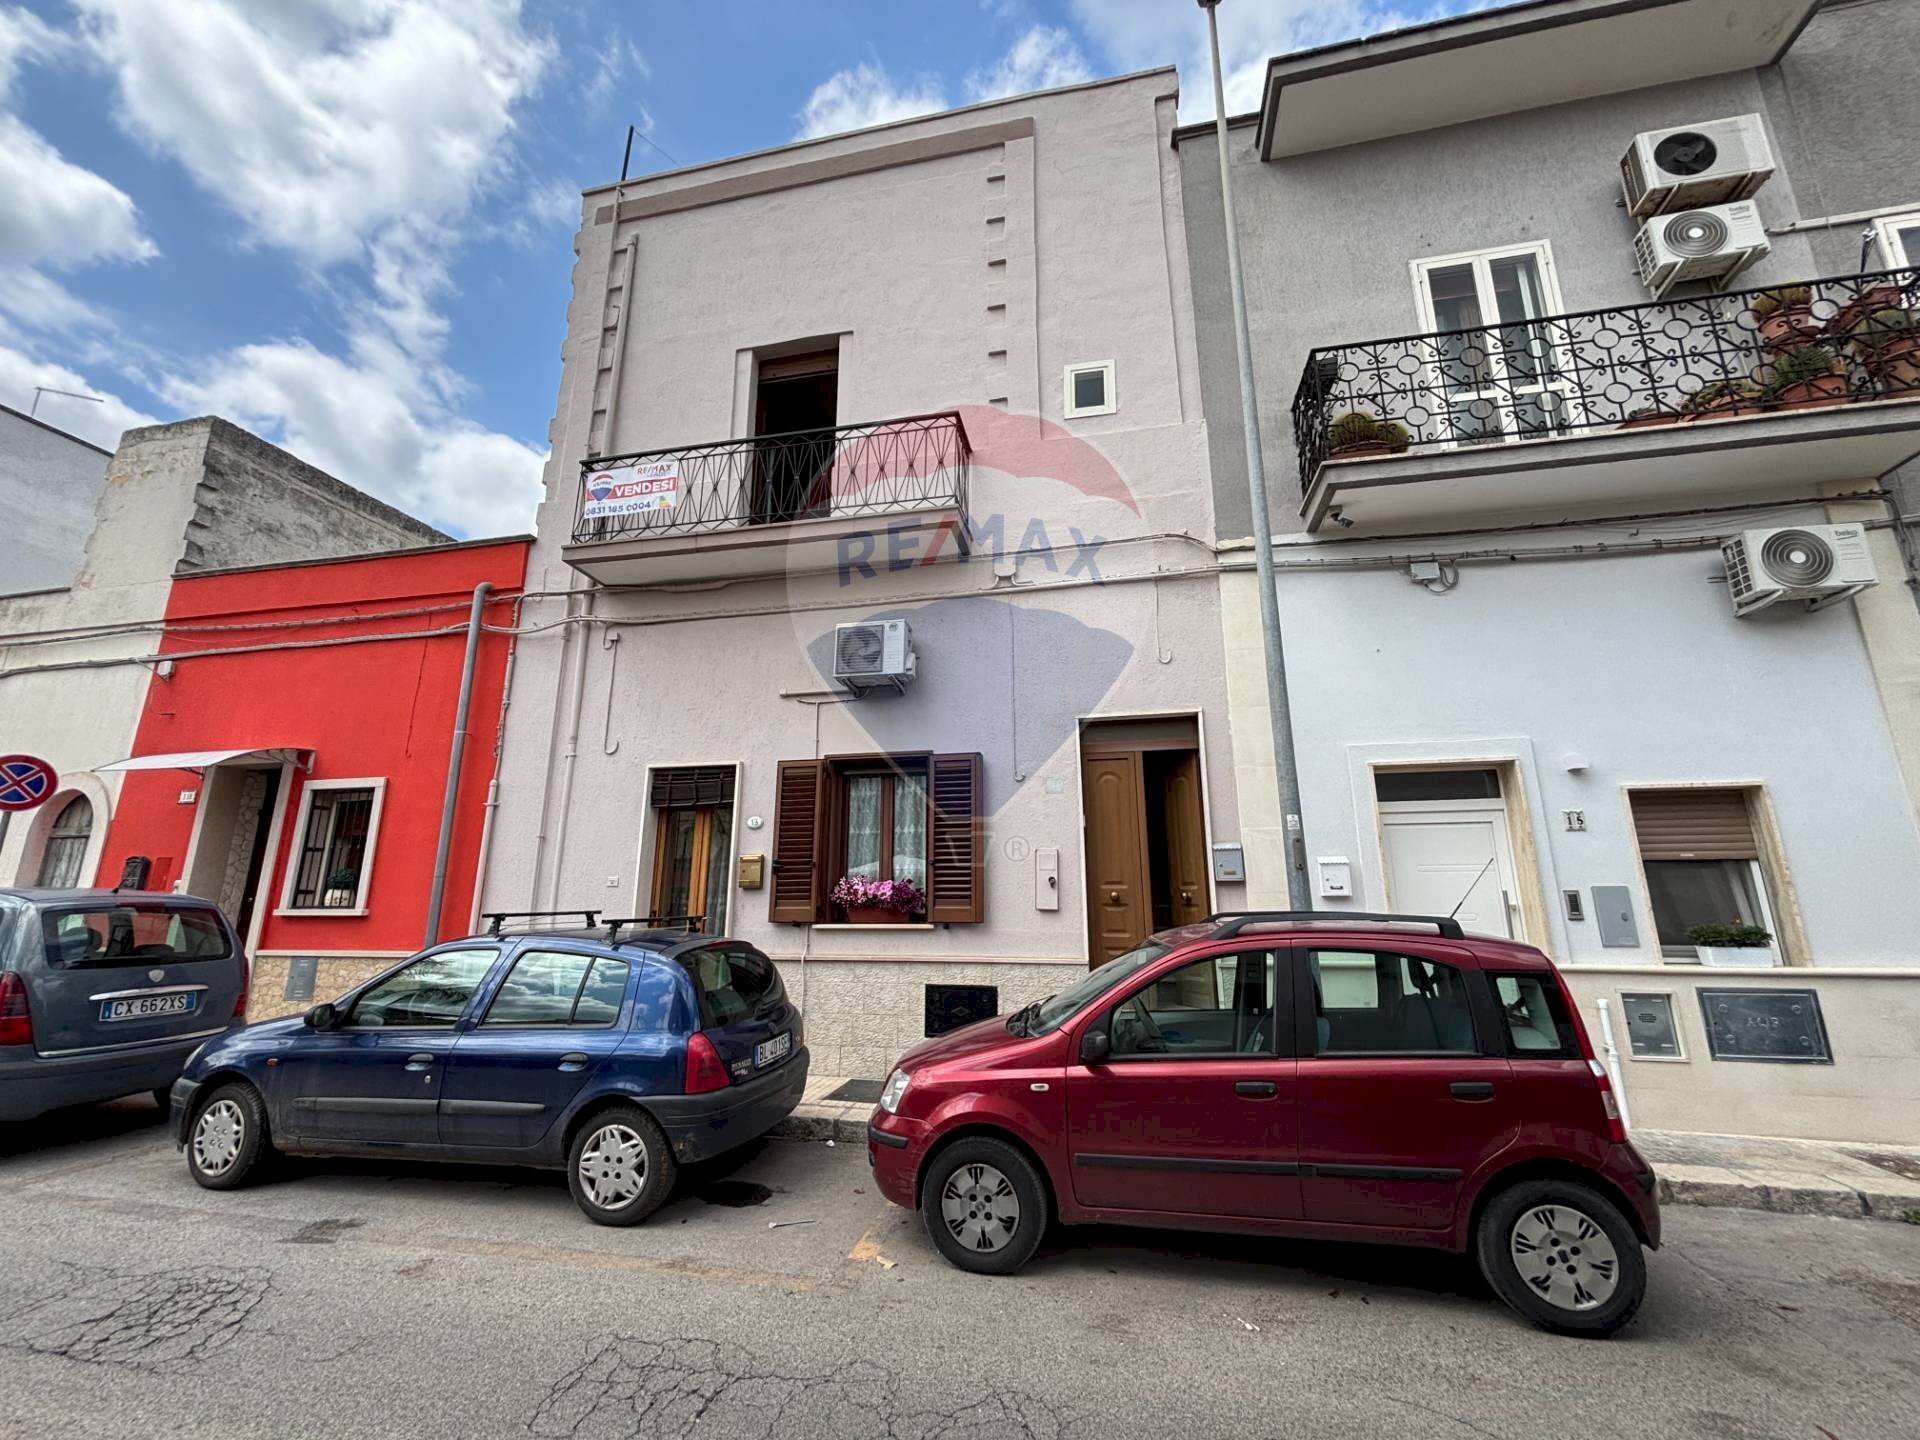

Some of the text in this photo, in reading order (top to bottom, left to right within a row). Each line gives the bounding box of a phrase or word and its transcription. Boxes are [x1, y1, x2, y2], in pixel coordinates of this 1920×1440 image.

[636, 464, 672, 475] RE/MAX
[615, 478, 674, 497] VENDESI
[586, 506, 606, 516] 0831
[626, 500, 652, 511] 0004
[1566, 815, 1584, 826] 15
[114, 995, 186, 1016] CX 662XS
